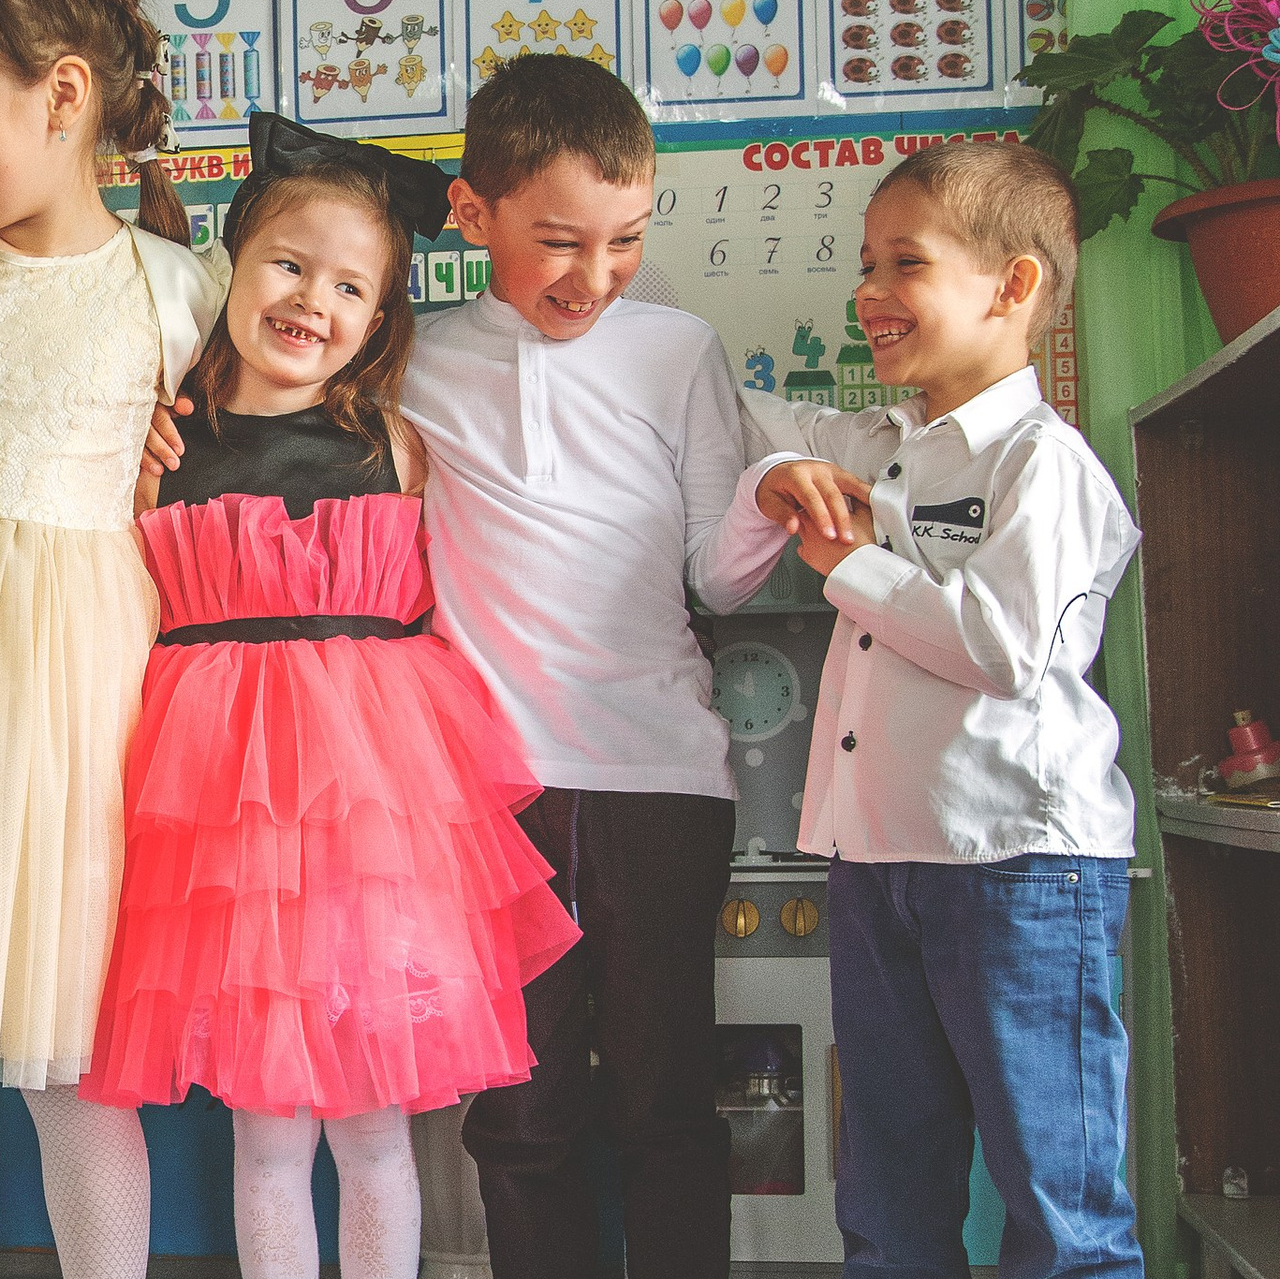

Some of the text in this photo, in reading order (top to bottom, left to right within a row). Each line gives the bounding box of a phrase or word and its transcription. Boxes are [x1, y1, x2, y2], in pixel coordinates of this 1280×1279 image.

[742, 137, 885, 171] СОСТАВ
[159, 155, 224, 181] БУКВ
[656, 181, 834, 216] 0 1 2 3
[814, 213, 828, 221] три
[709, 234, 835, 267] 6 7 8
[1059, 313, 1069, 326] 3
[1059, 336, 1069, 350] 4
[1061, 361, 1070, 374] 5
[848, 368, 856, 381] 1
[1061, 385, 1071, 398] 6
[816, 393, 825, 405] 3
[848, 392, 877, 405] 2 3
[742, 653, 759, 662] 12
[781, 685, 790, 697] 3
[745, 718, 754, 730] 6
